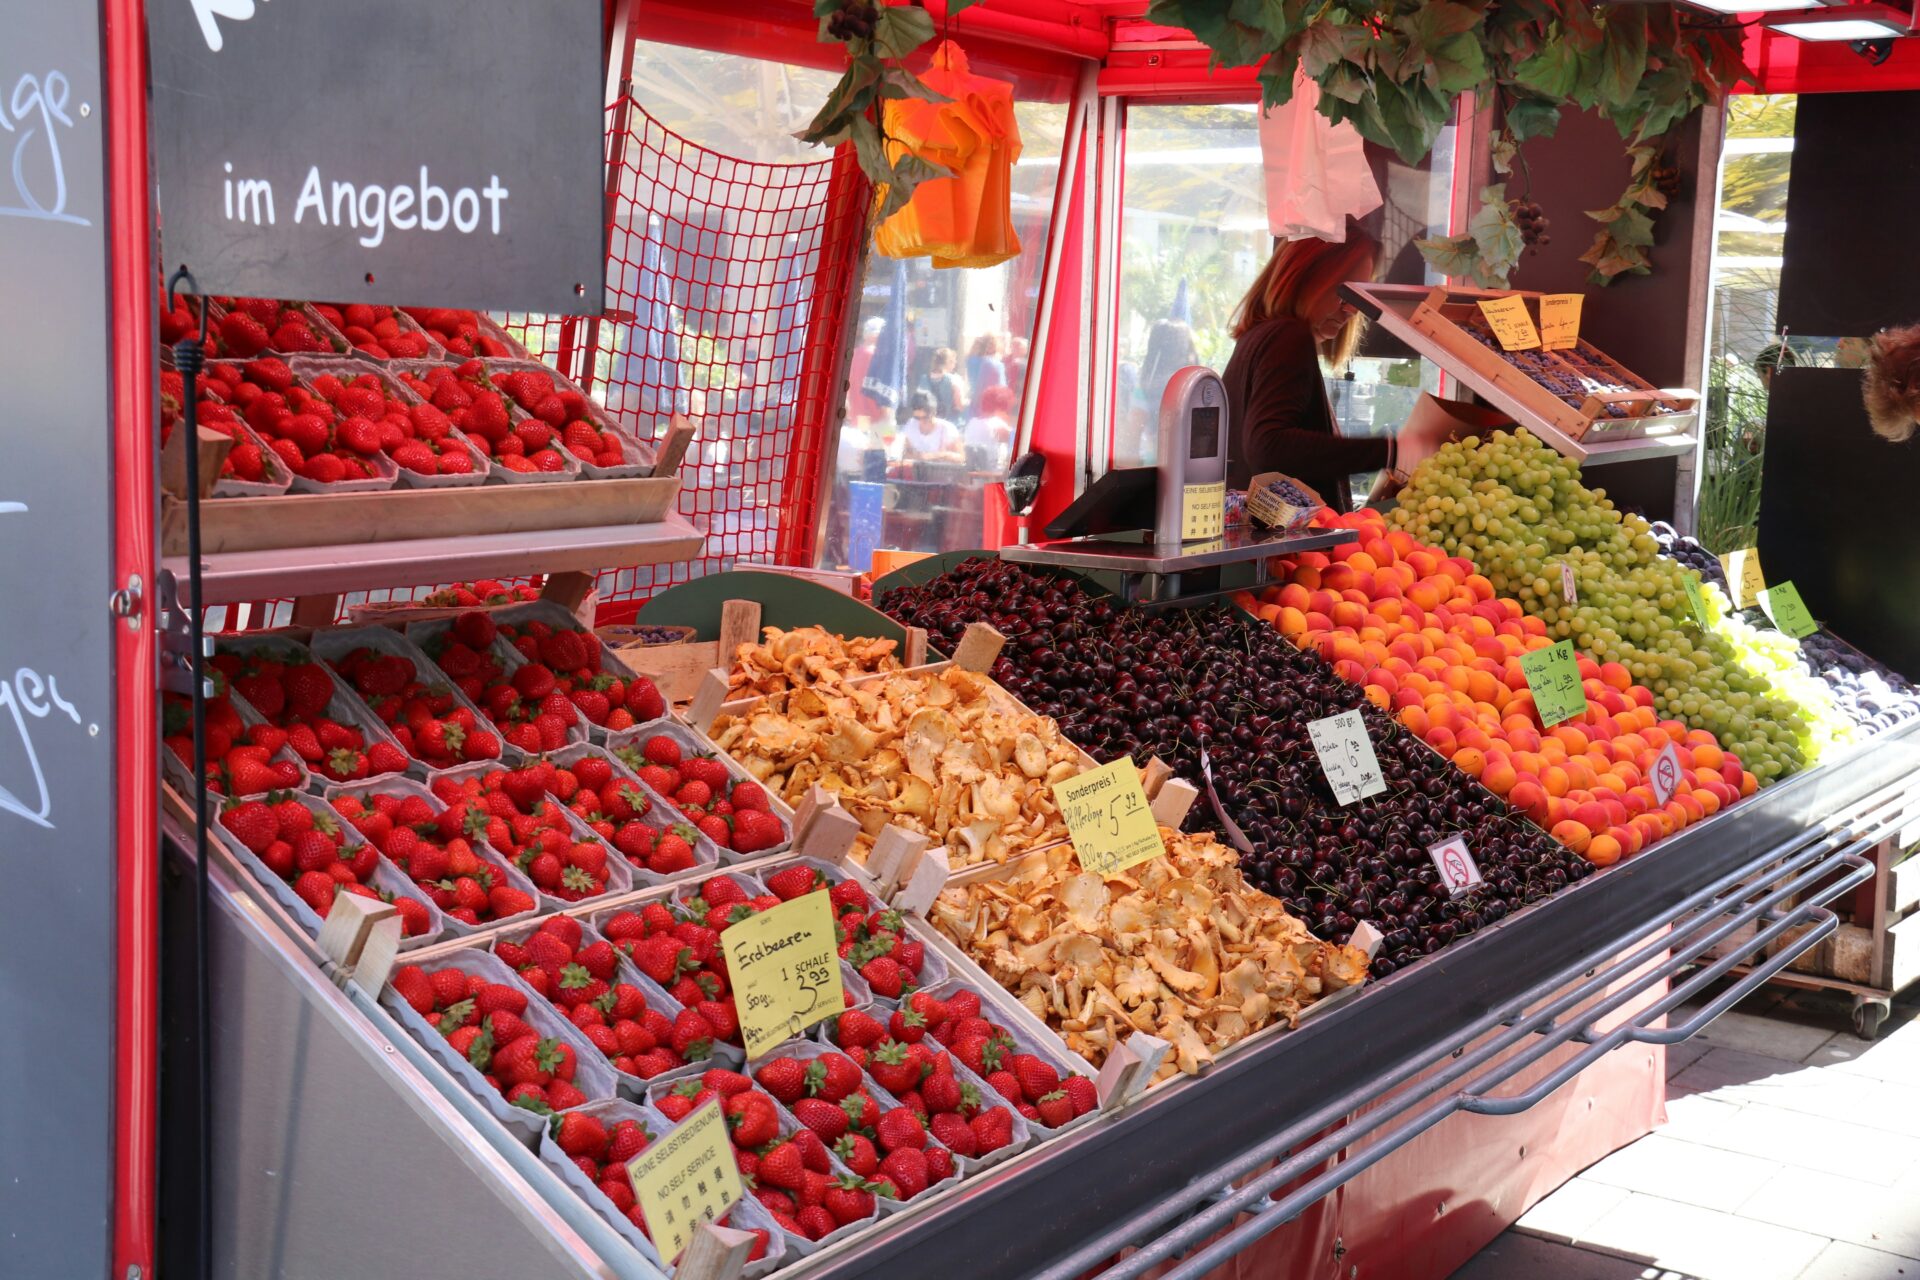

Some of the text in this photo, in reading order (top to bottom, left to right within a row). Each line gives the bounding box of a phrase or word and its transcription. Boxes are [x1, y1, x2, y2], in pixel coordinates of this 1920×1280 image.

[223, 162, 510, 249] im Angebot
[1548, 648, 1569, 662] 1 Kg
[1334, 717, 1346, 729] 500
[1066, 771, 1118, 803] Sonderpreis !
[1080, 842, 1096, 868] 250
[733, 930, 813, 971] Erdbeeren
[781, 952, 830, 982] 1 SCHALE
[633, 1106, 721, 1182] KEINE SELBSTBEDIENUNG
[657, 1145, 718, 1201] NO SELF SERVICE
